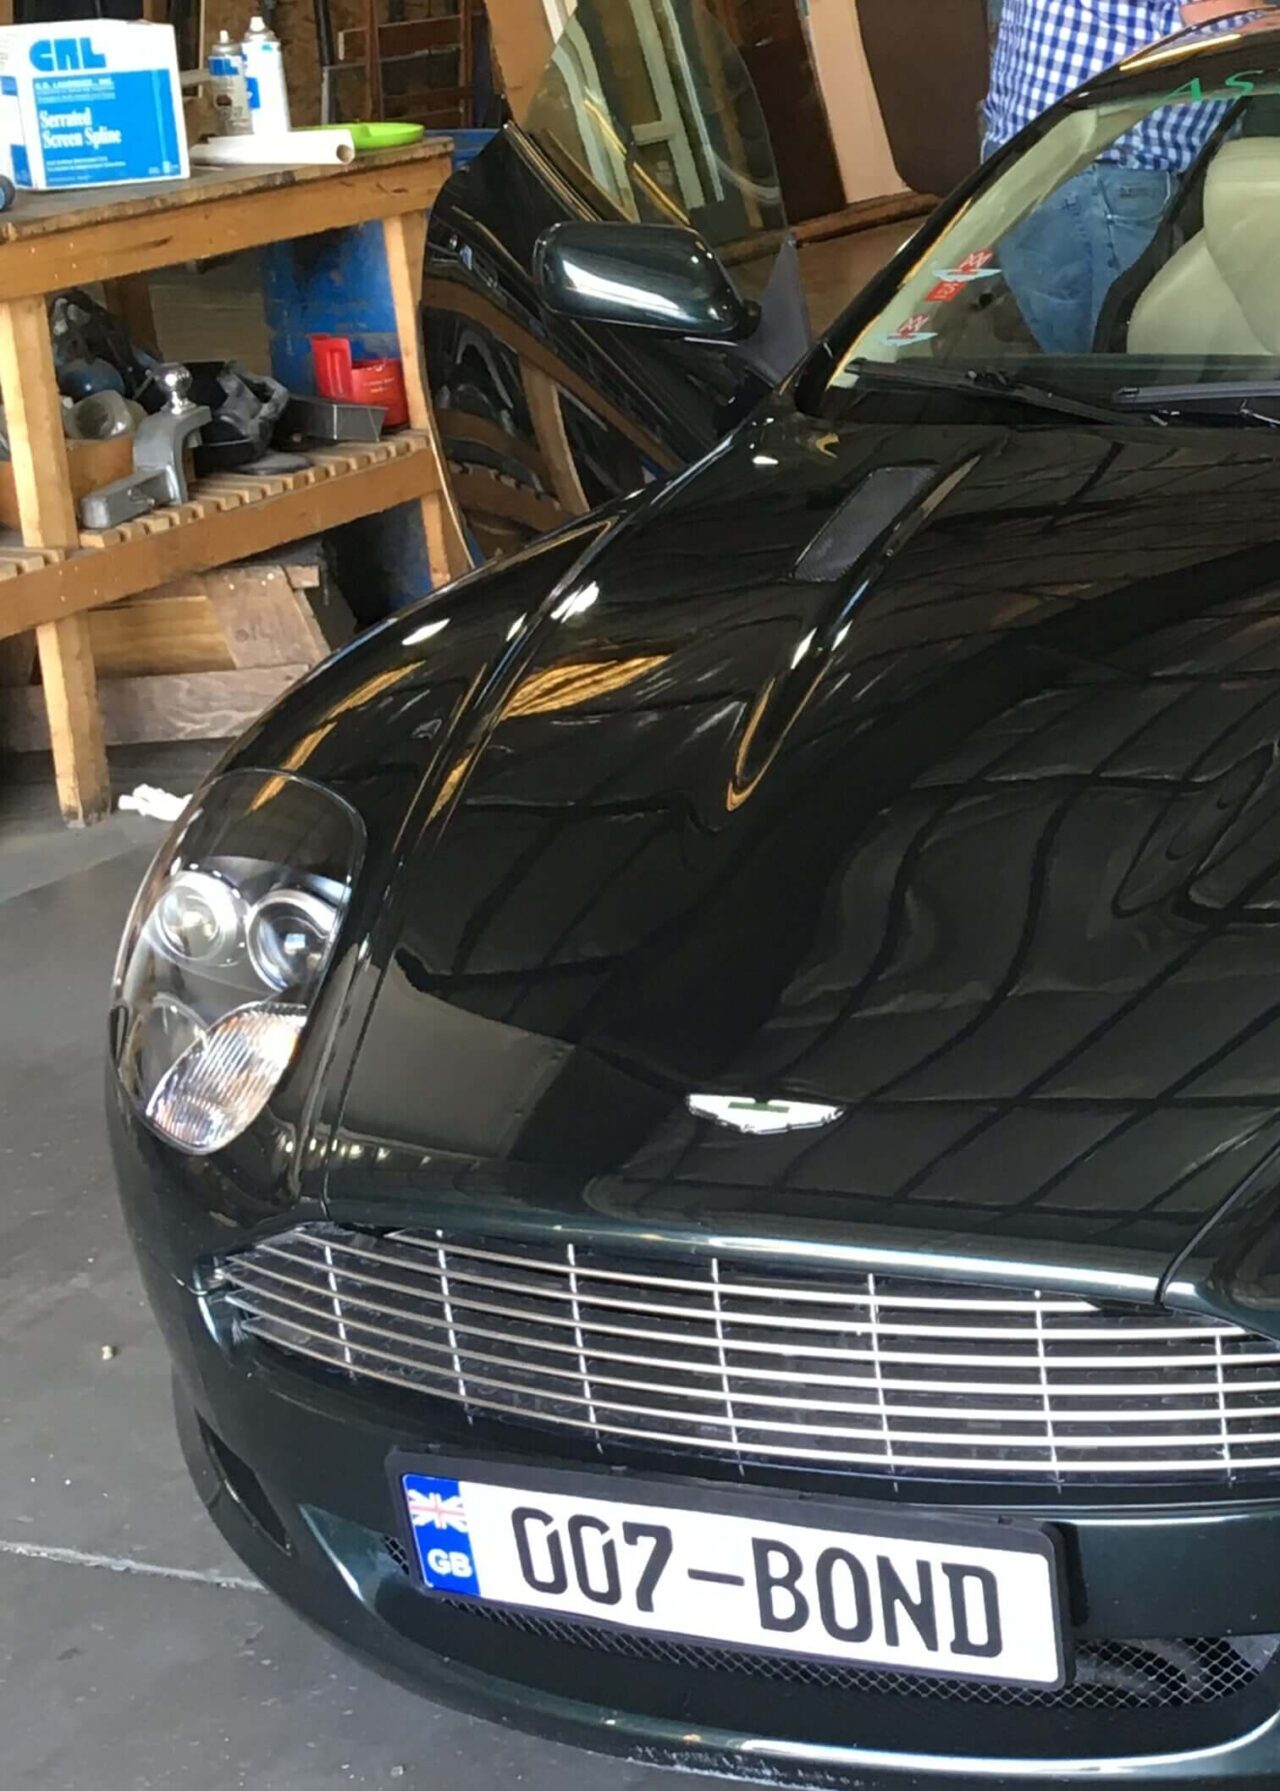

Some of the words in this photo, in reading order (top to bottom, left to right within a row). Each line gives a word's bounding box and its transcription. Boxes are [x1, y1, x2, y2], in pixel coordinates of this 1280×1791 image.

[39, 107, 92, 129] Serrated
[42, 130, 83, 149] Screen
[84, 125, 122, 150] Spline
[427, 1548, 473, 1578] GB
